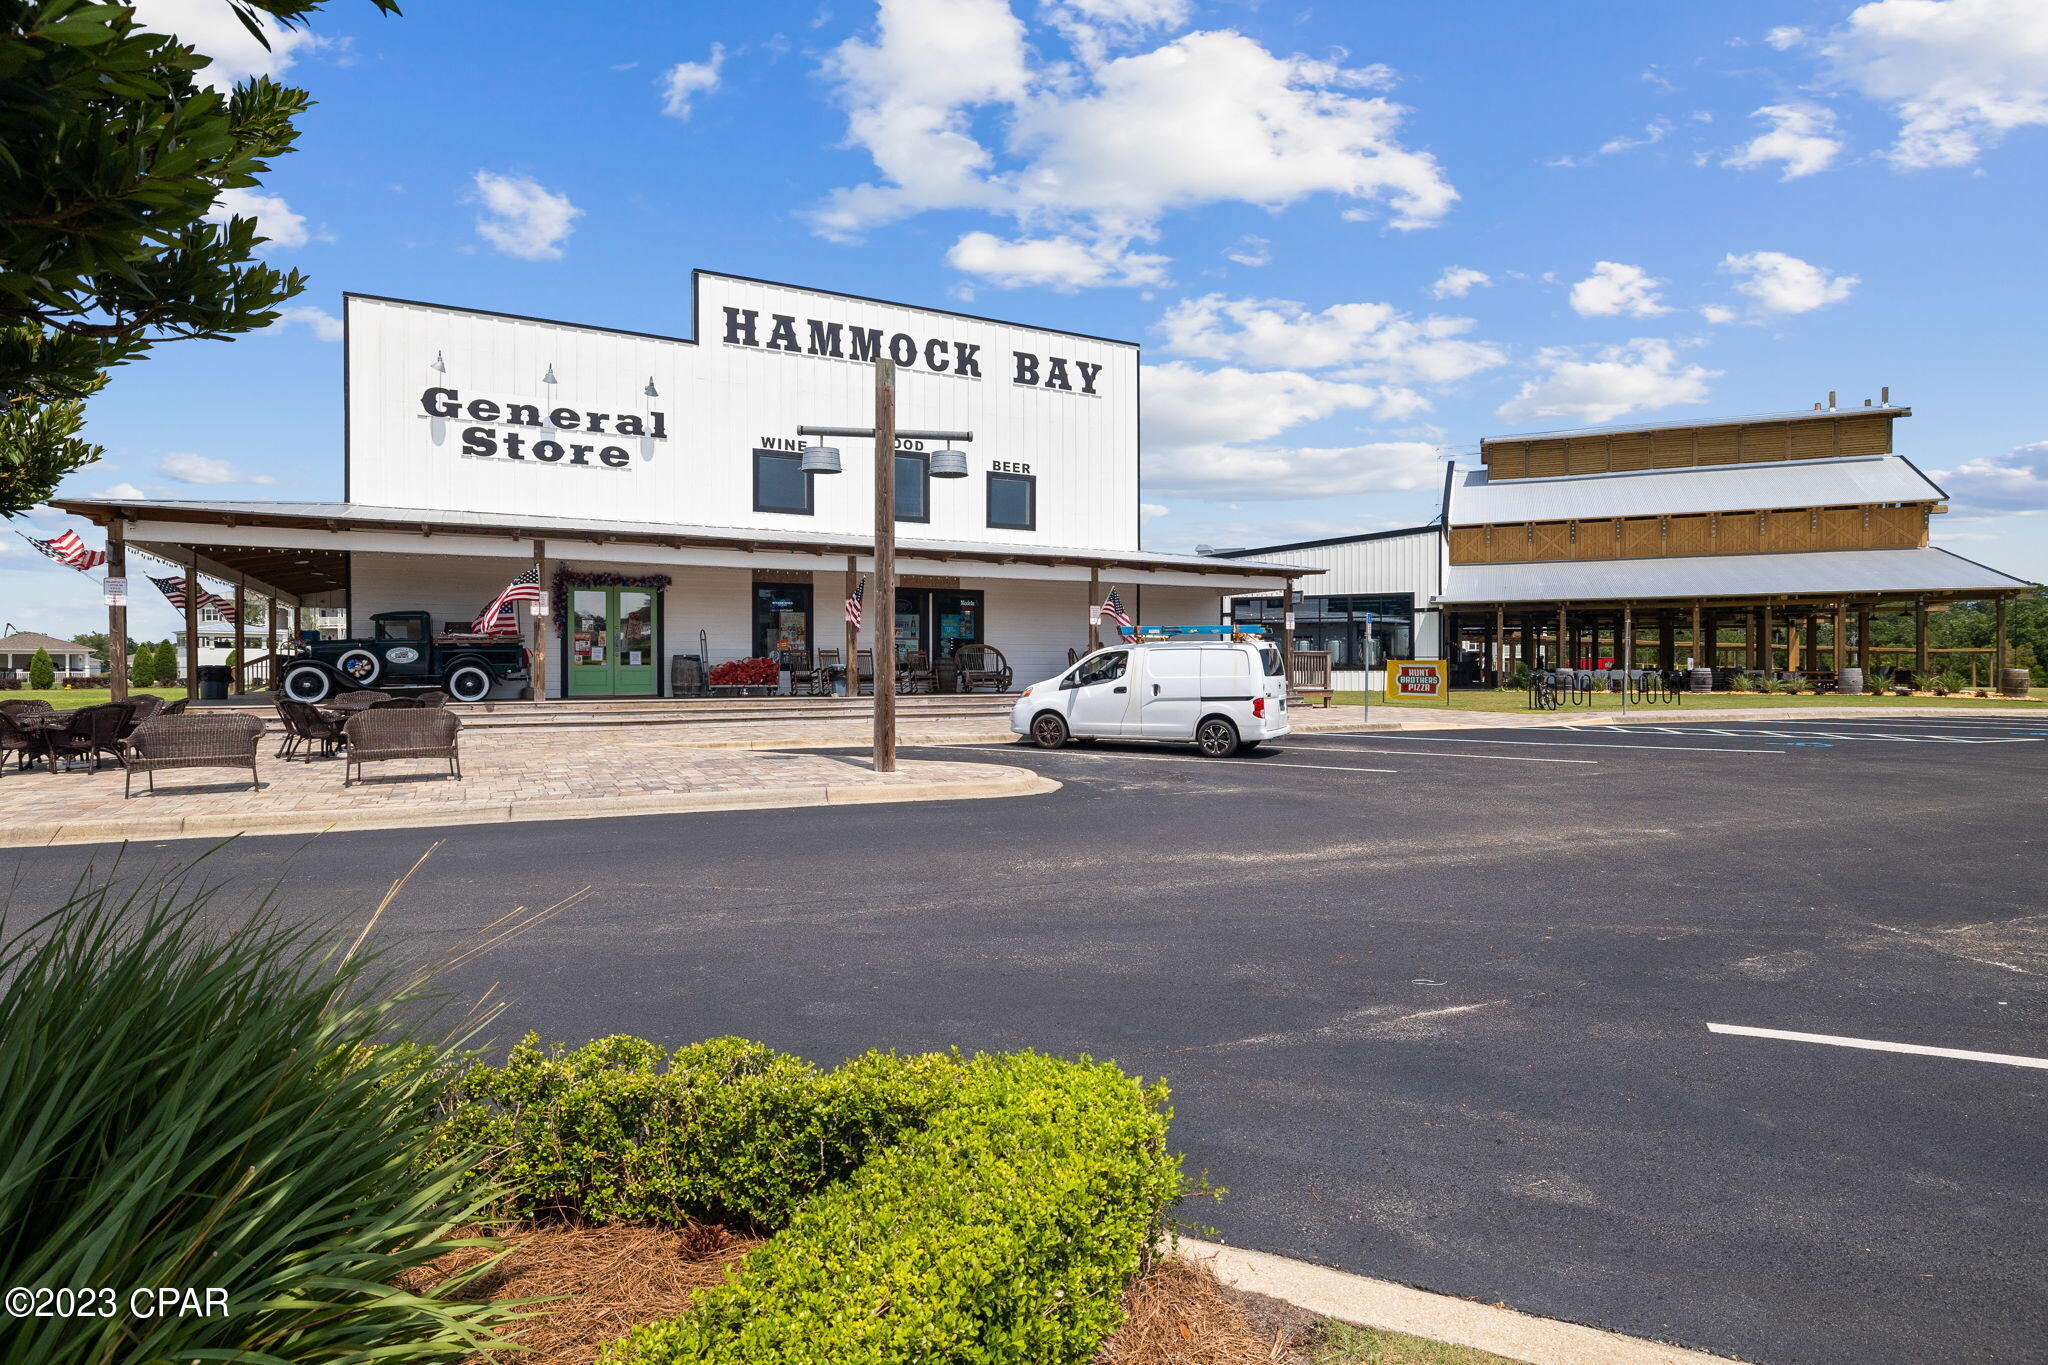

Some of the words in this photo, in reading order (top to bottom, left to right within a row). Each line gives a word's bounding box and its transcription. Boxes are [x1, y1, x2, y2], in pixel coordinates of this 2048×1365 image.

[722, 306, 982, 377] HAMMOCK
[1012, 351, 1103, 395] BAY
[420, 386, 668, 439] General
[461, 426, 630, 468] Store
[761, 436, 807, 451] WINE
[895, 438, 924, 451] OOD
[992, 460, 1031, 474] BEER
[1408, 668, 1429, 676] HUNT
[1400, 676, 1438, 684] BROTHERS
[1408, 683, 1430, 692] PIZZA
